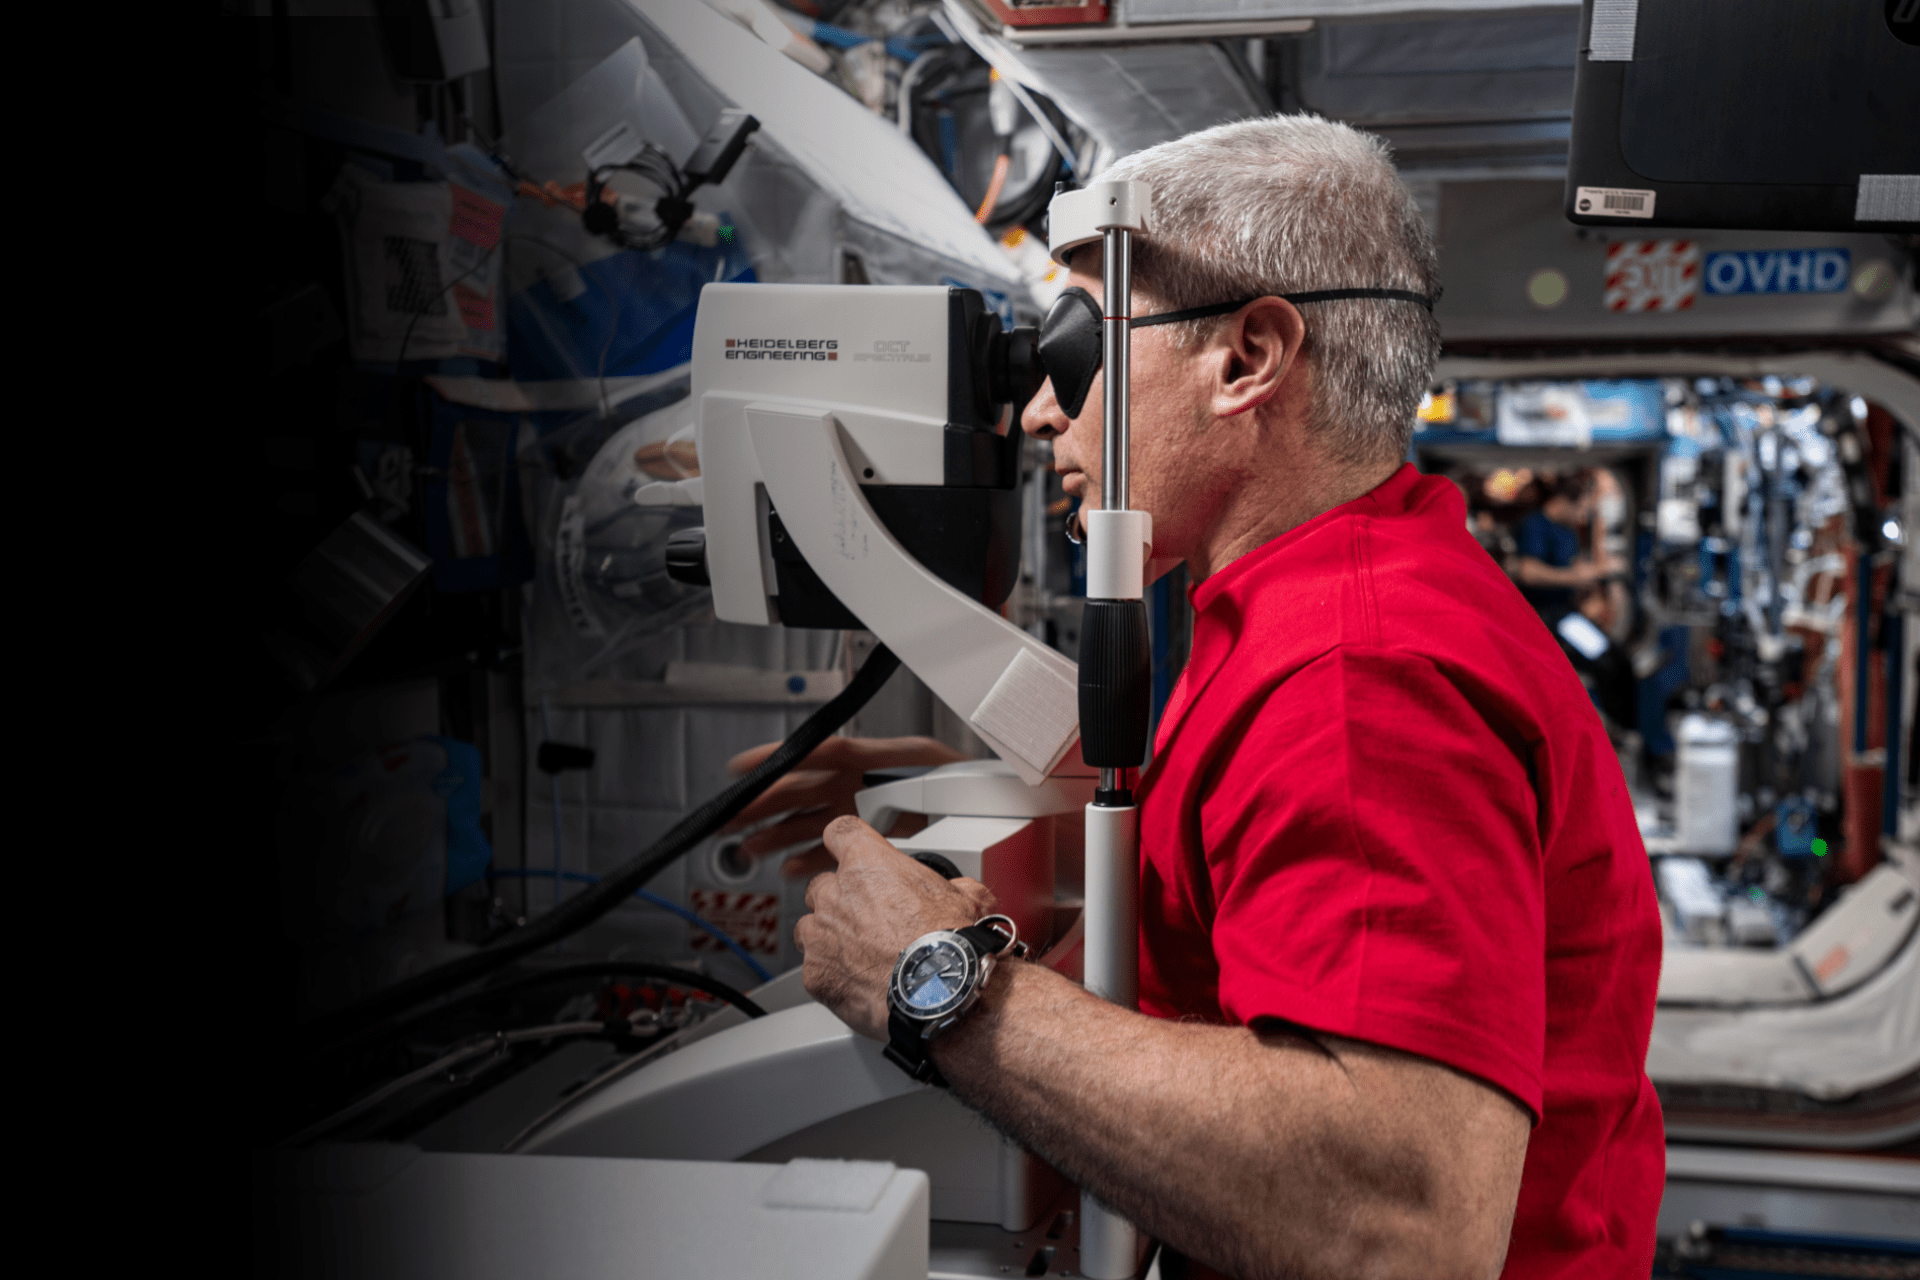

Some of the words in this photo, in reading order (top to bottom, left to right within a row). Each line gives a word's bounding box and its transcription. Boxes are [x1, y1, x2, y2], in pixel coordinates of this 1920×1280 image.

[1708, 252, 1848, 292] OVHD
[737, 339, 838, 349] HEIDELBERG
[874, 341, 910, 352] OCT
[725, 350, 826, 360] ENGINEERING
